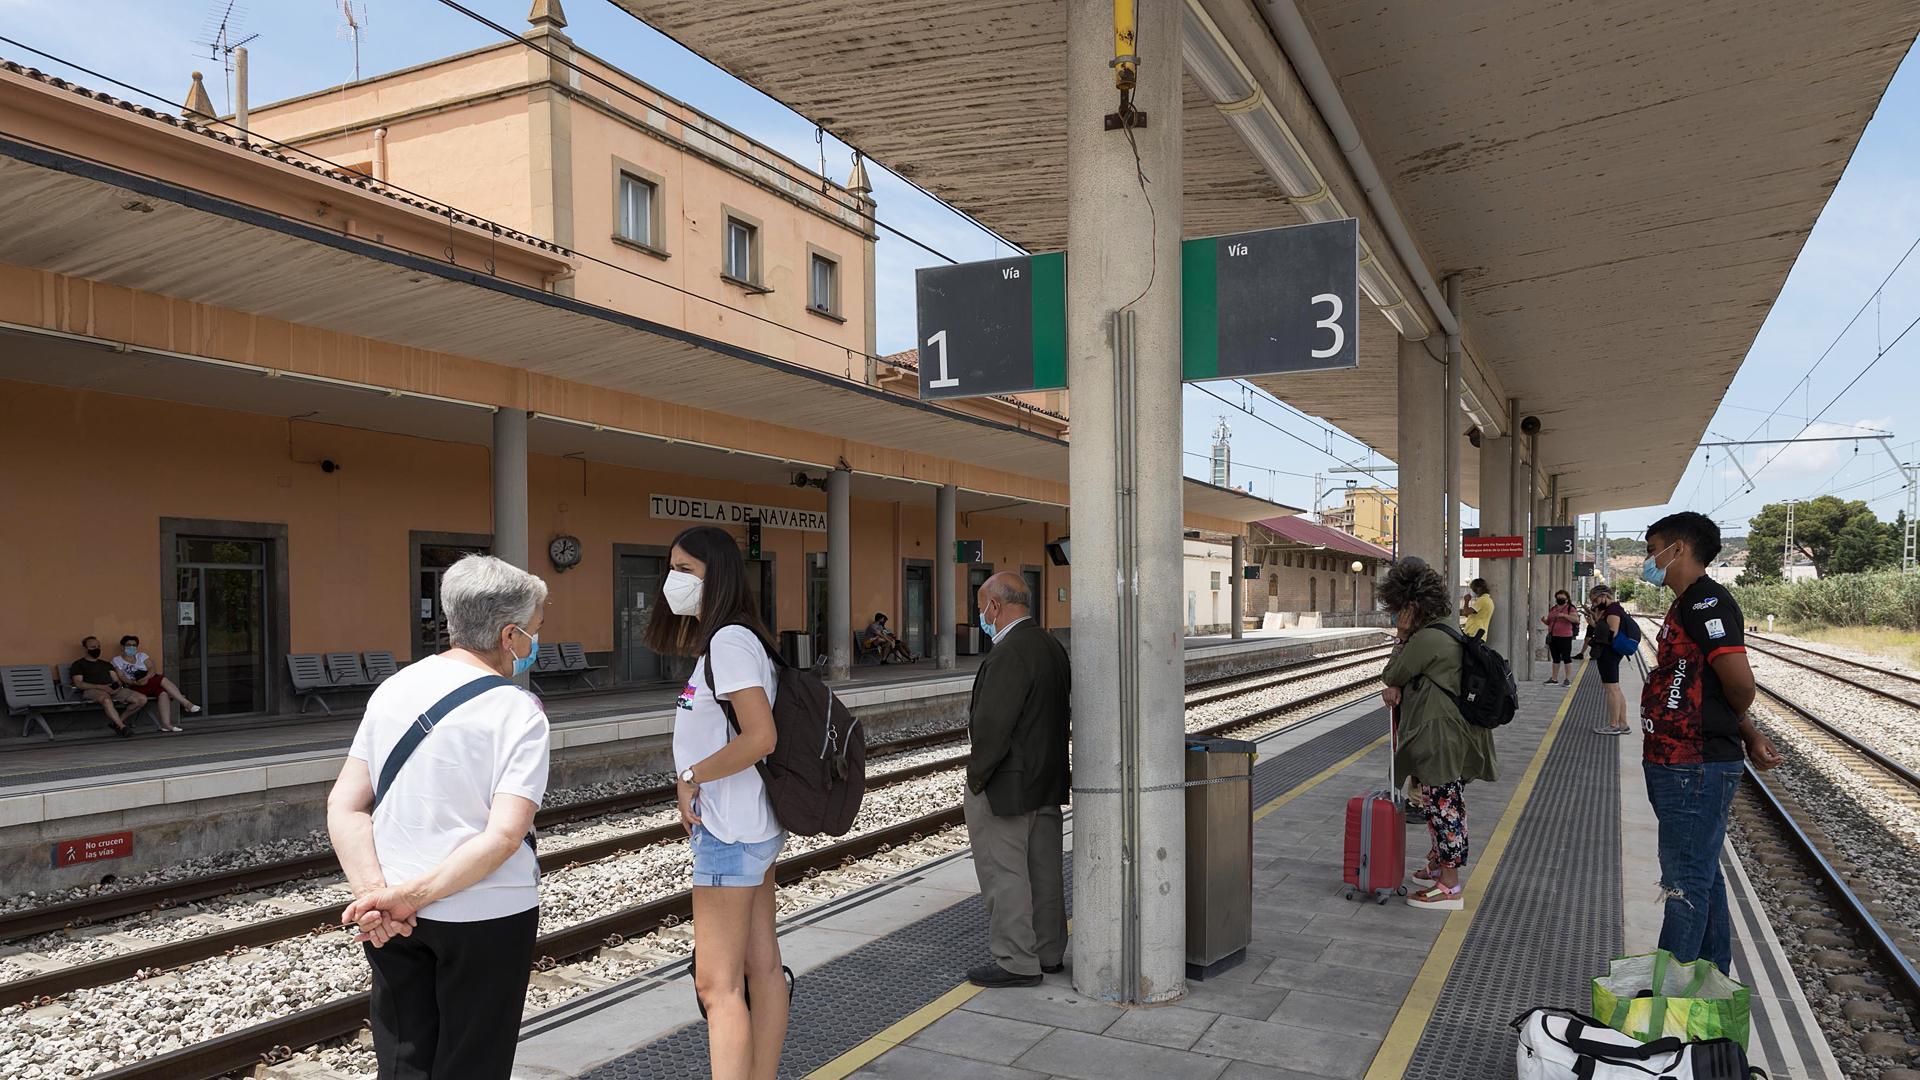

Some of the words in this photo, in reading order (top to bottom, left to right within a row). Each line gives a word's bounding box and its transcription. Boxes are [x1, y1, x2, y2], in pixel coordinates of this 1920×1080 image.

[1228, 242, 1249, 257] Vía
[1002, 266, 1020, 280] Vía
[1310, 293, 1345, 359] 3
[926, 330, 960, 389] 1
[652, 497, 726, 521] TUDELA
[732, 505, 753, 523] DE
[759, 508, 826, 529] NAVARRA
[1564, 539, 1573, 553] 3
[975, 550, 981, 562] 2
[1588, 568, 1594, 576] 3
[98, 838, 123, 847] crucen
[98, 848, 114, 856] vías
